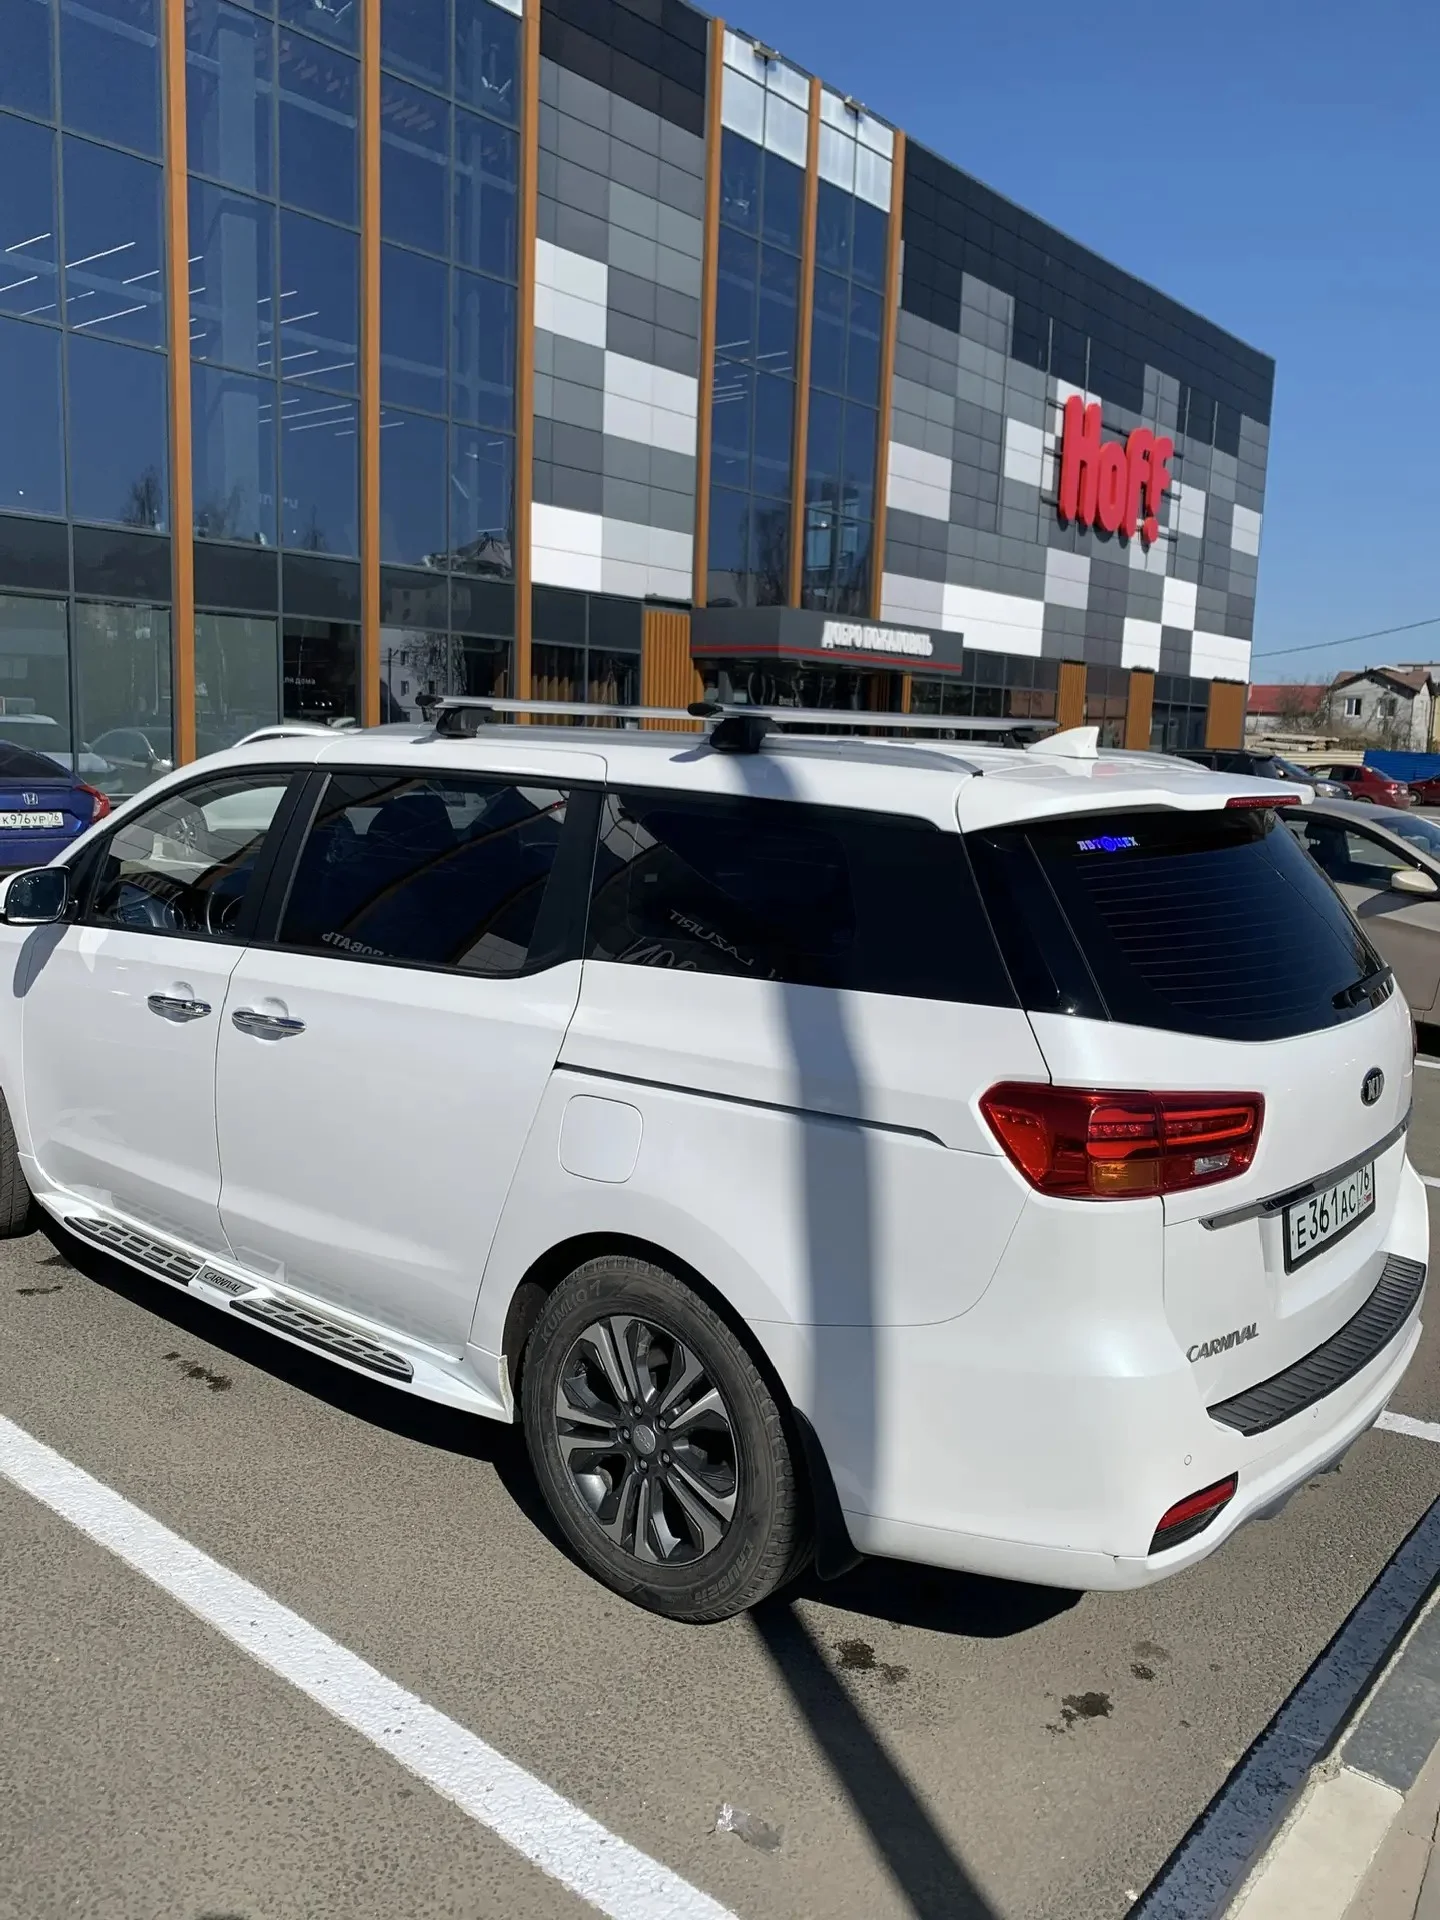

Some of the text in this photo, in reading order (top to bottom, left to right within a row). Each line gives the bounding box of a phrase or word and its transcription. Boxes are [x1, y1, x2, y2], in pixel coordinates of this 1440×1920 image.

[1059, 394, 1174, 544] Hoff
[204, 1271, 241, 1293] CARNIVAL
[1186, 1322, 1259, 1363] CARNIVAL
